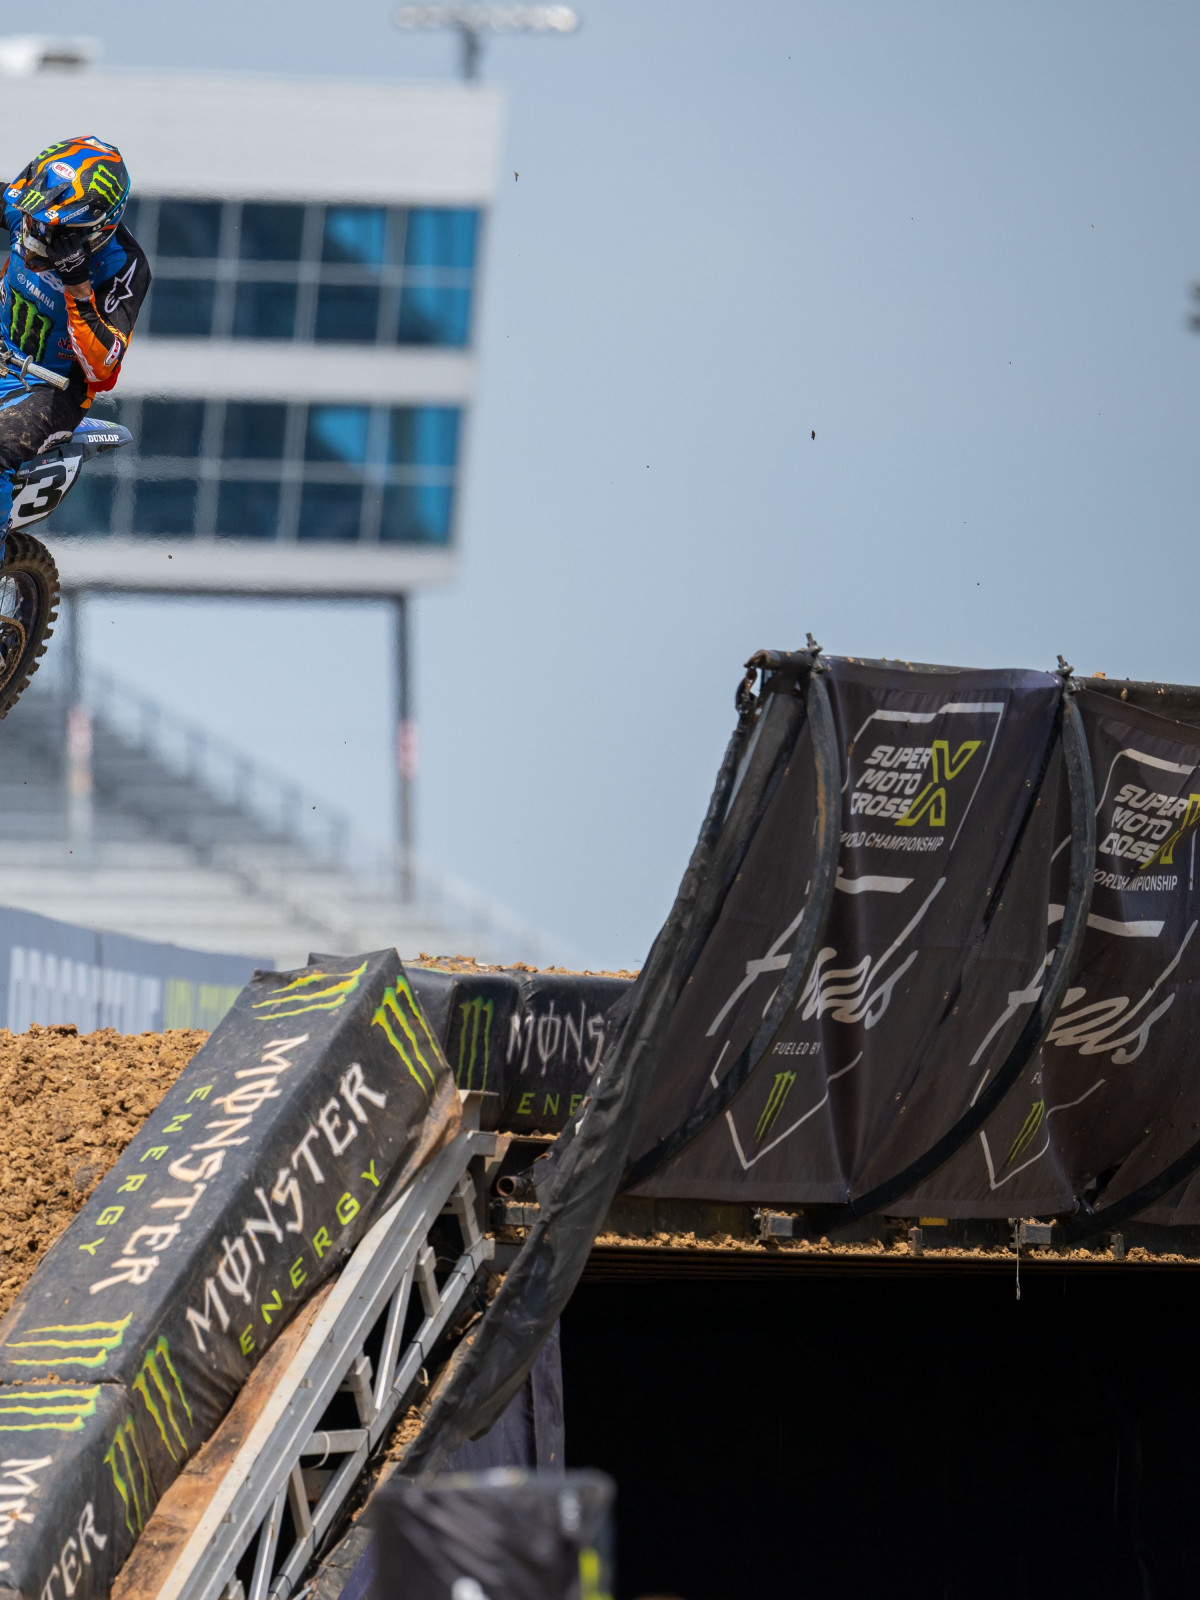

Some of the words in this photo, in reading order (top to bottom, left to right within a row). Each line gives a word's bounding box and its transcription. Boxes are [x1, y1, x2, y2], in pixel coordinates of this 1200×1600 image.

[25, 279, 55, 310] YAMAHA
[87, 434, 119, 443] DUNLOP
[17, 464, 67, 518] 3
[864, 744, 934, 770] SUPER
[855, 768, 923, 796] MOTO
[1113, 783, 1190, 819] SUPER
[1111, 806, 1173, 841] MOTO
[864, 831, 945, 852] CHAMPIONSHIP
[772, 1041, 810, 1056] FUELED
[808, 1041, 823, 1056] BY
[78, 1084, 214, 1257] ENERGY
[238, 1158, 381, 1357] ENERGY
